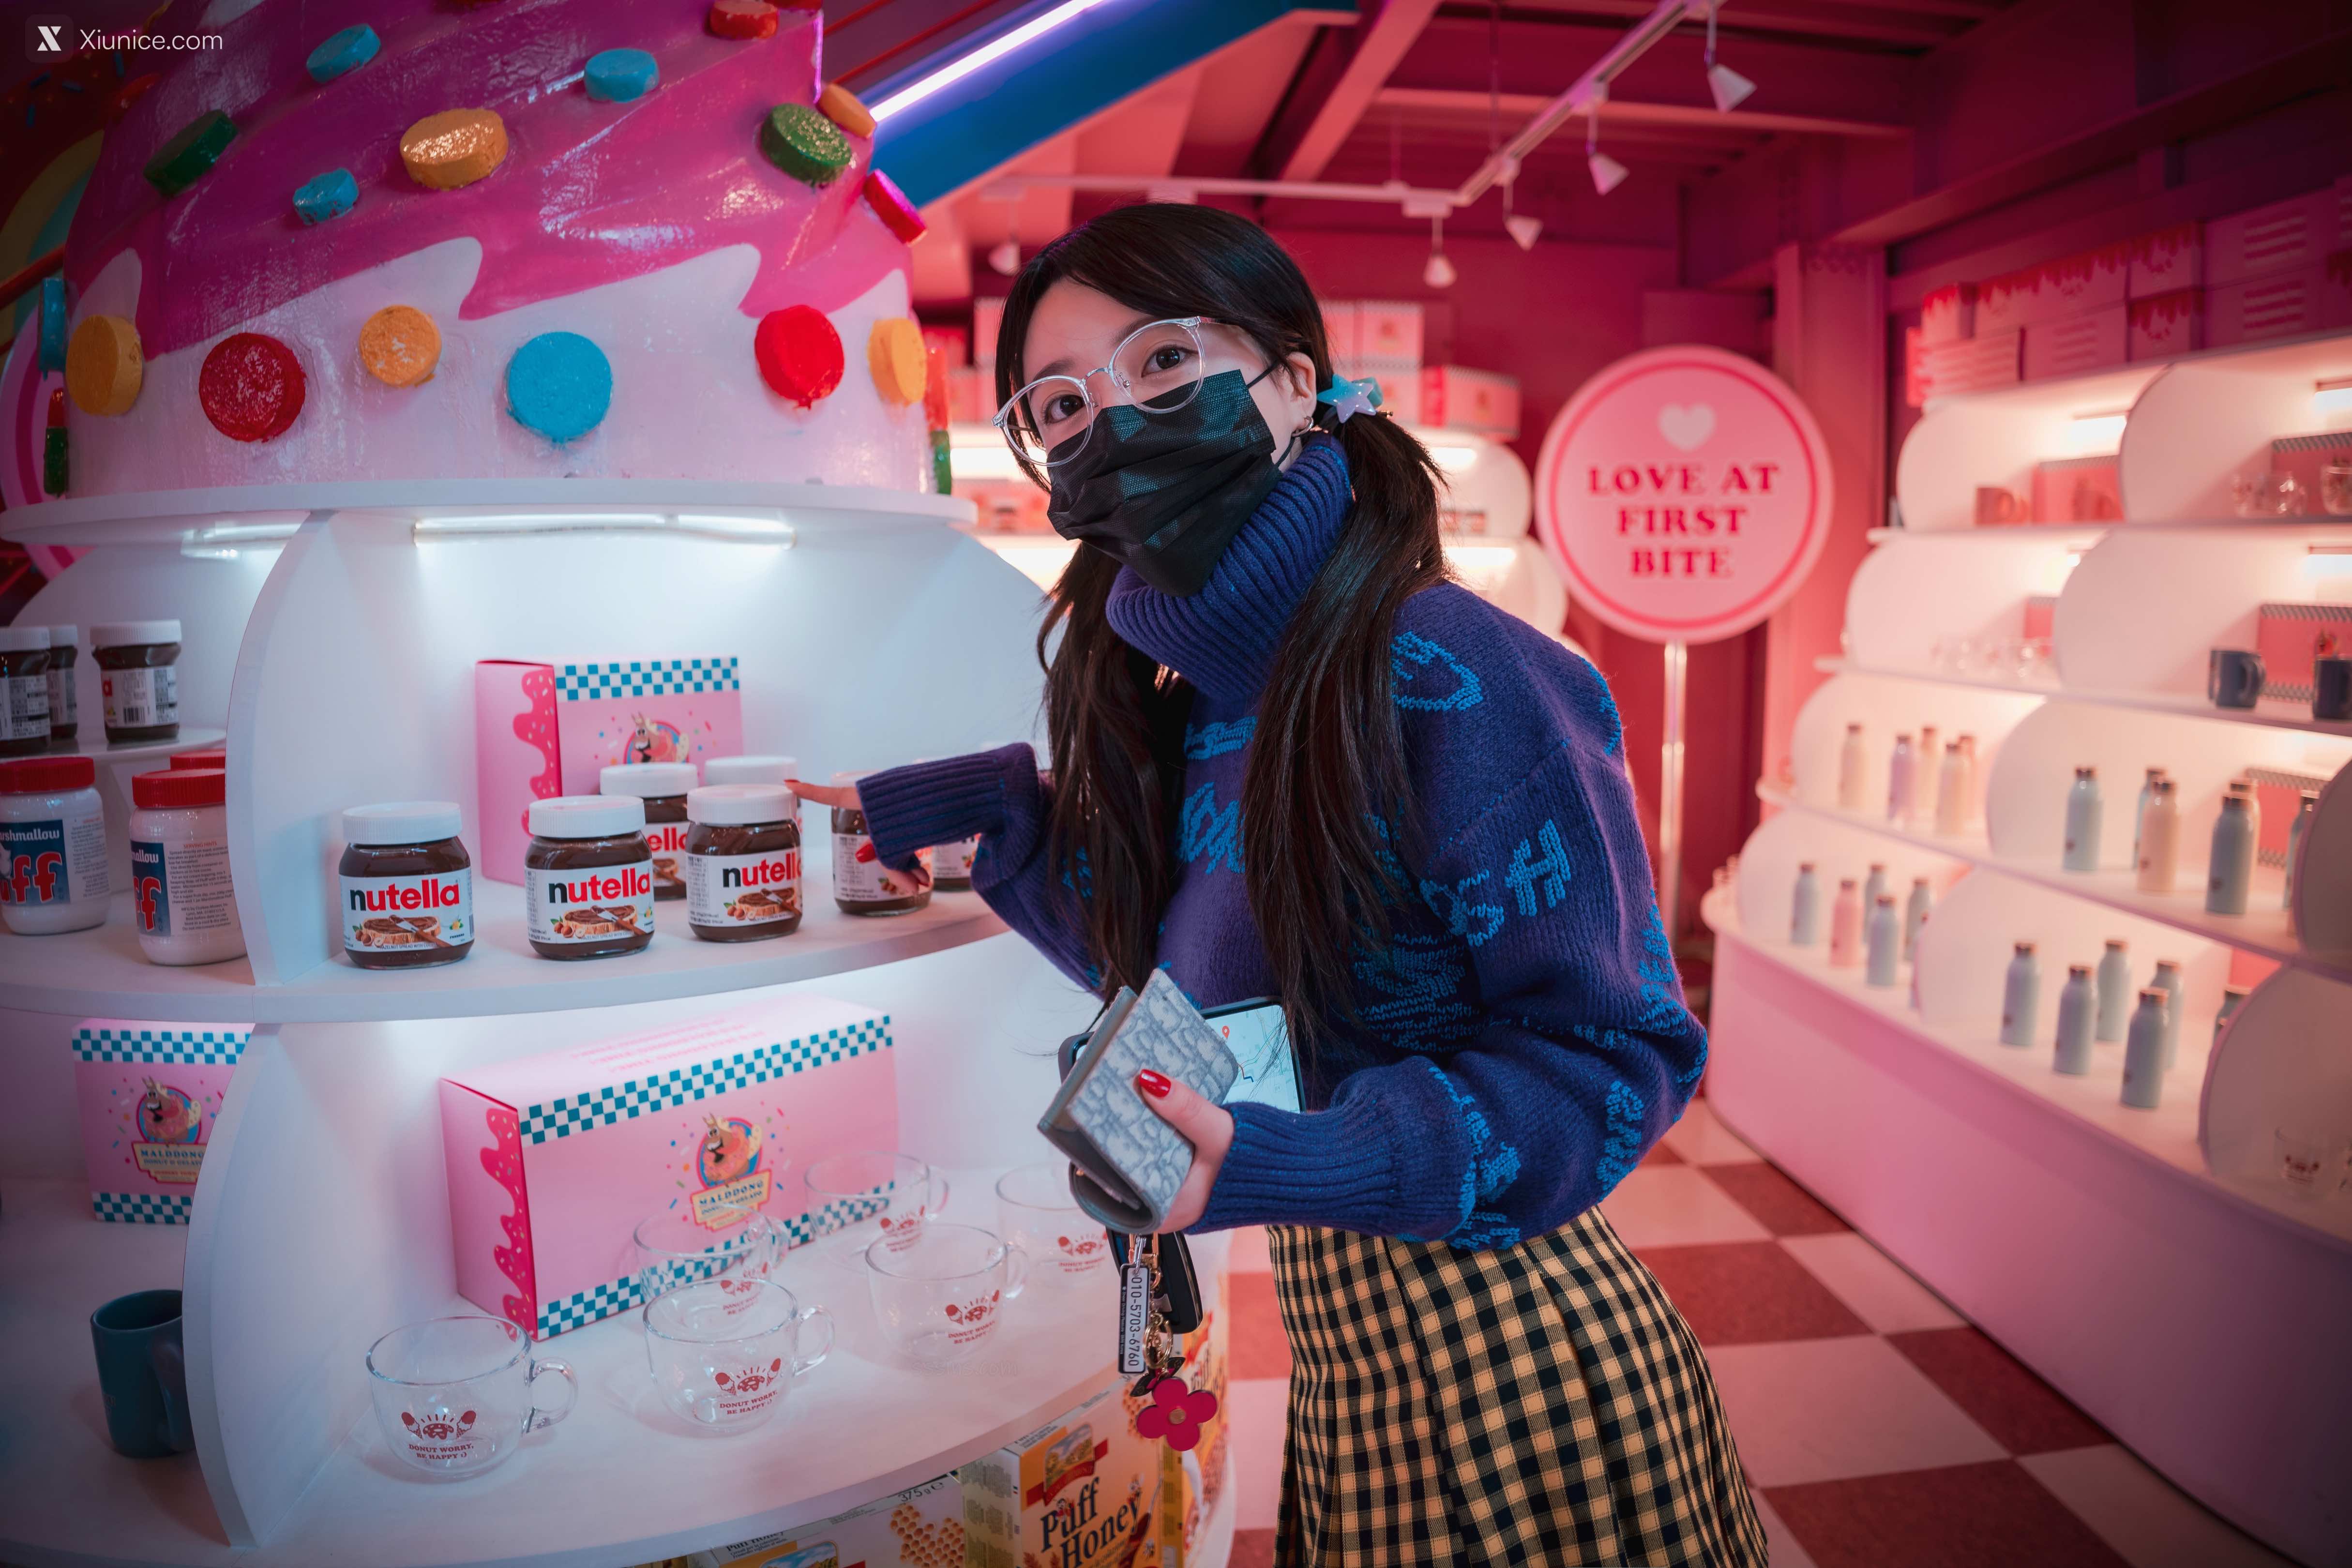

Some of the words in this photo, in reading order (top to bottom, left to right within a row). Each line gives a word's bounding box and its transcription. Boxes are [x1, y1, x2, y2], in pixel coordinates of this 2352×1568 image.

[1588, 463, 1707, 497] LOVE
[1722, 462, 1779, 494] AT
[1618, 507, 1748, 536] FIRST
[1630, 549, 1733, 576] BITE
[349, 878, 460, 912] nutella
[548, 867, 651, 904] nutella
[1128, 1276, 1143, 1367] 010-5703-6760
[719, 1400, 750, 1409] DONUT
[739, 1402, 766, 1413] HAPPY
[408, 1443, 438, 1453] DONUT
[898, 1489, 922, 1502] 375
[1040, 1476, 1100, 1553] Puff
[1060, 1497, 1142, 1568] Honey
